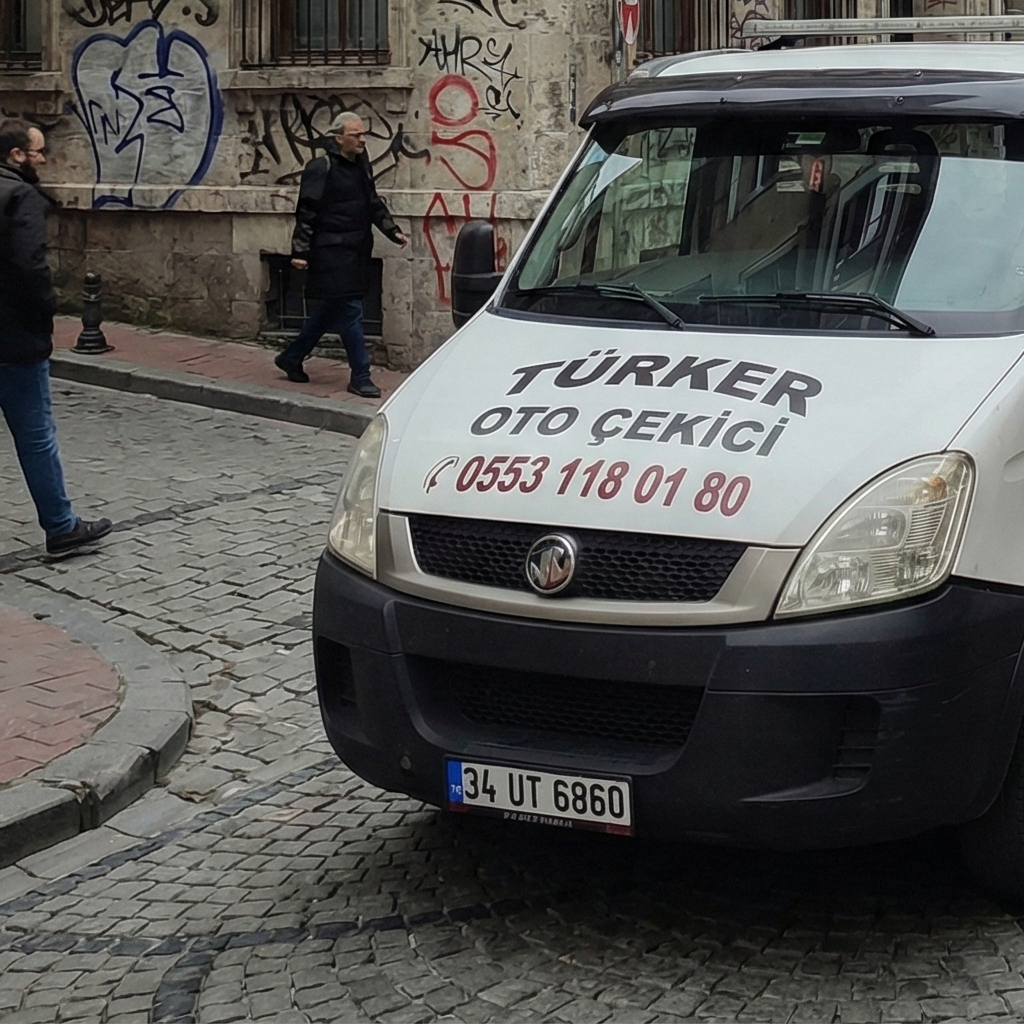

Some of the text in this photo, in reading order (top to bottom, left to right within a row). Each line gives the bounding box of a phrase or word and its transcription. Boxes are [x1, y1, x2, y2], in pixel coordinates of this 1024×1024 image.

[505, 348, 823, 417] TÜRKER
[470, 406, 790, 456] OTO ÇEKİCİ
[456, 455, 751, 517] 0553 118 01 80
[463, 767, 624, 819] 34 UT 6860
